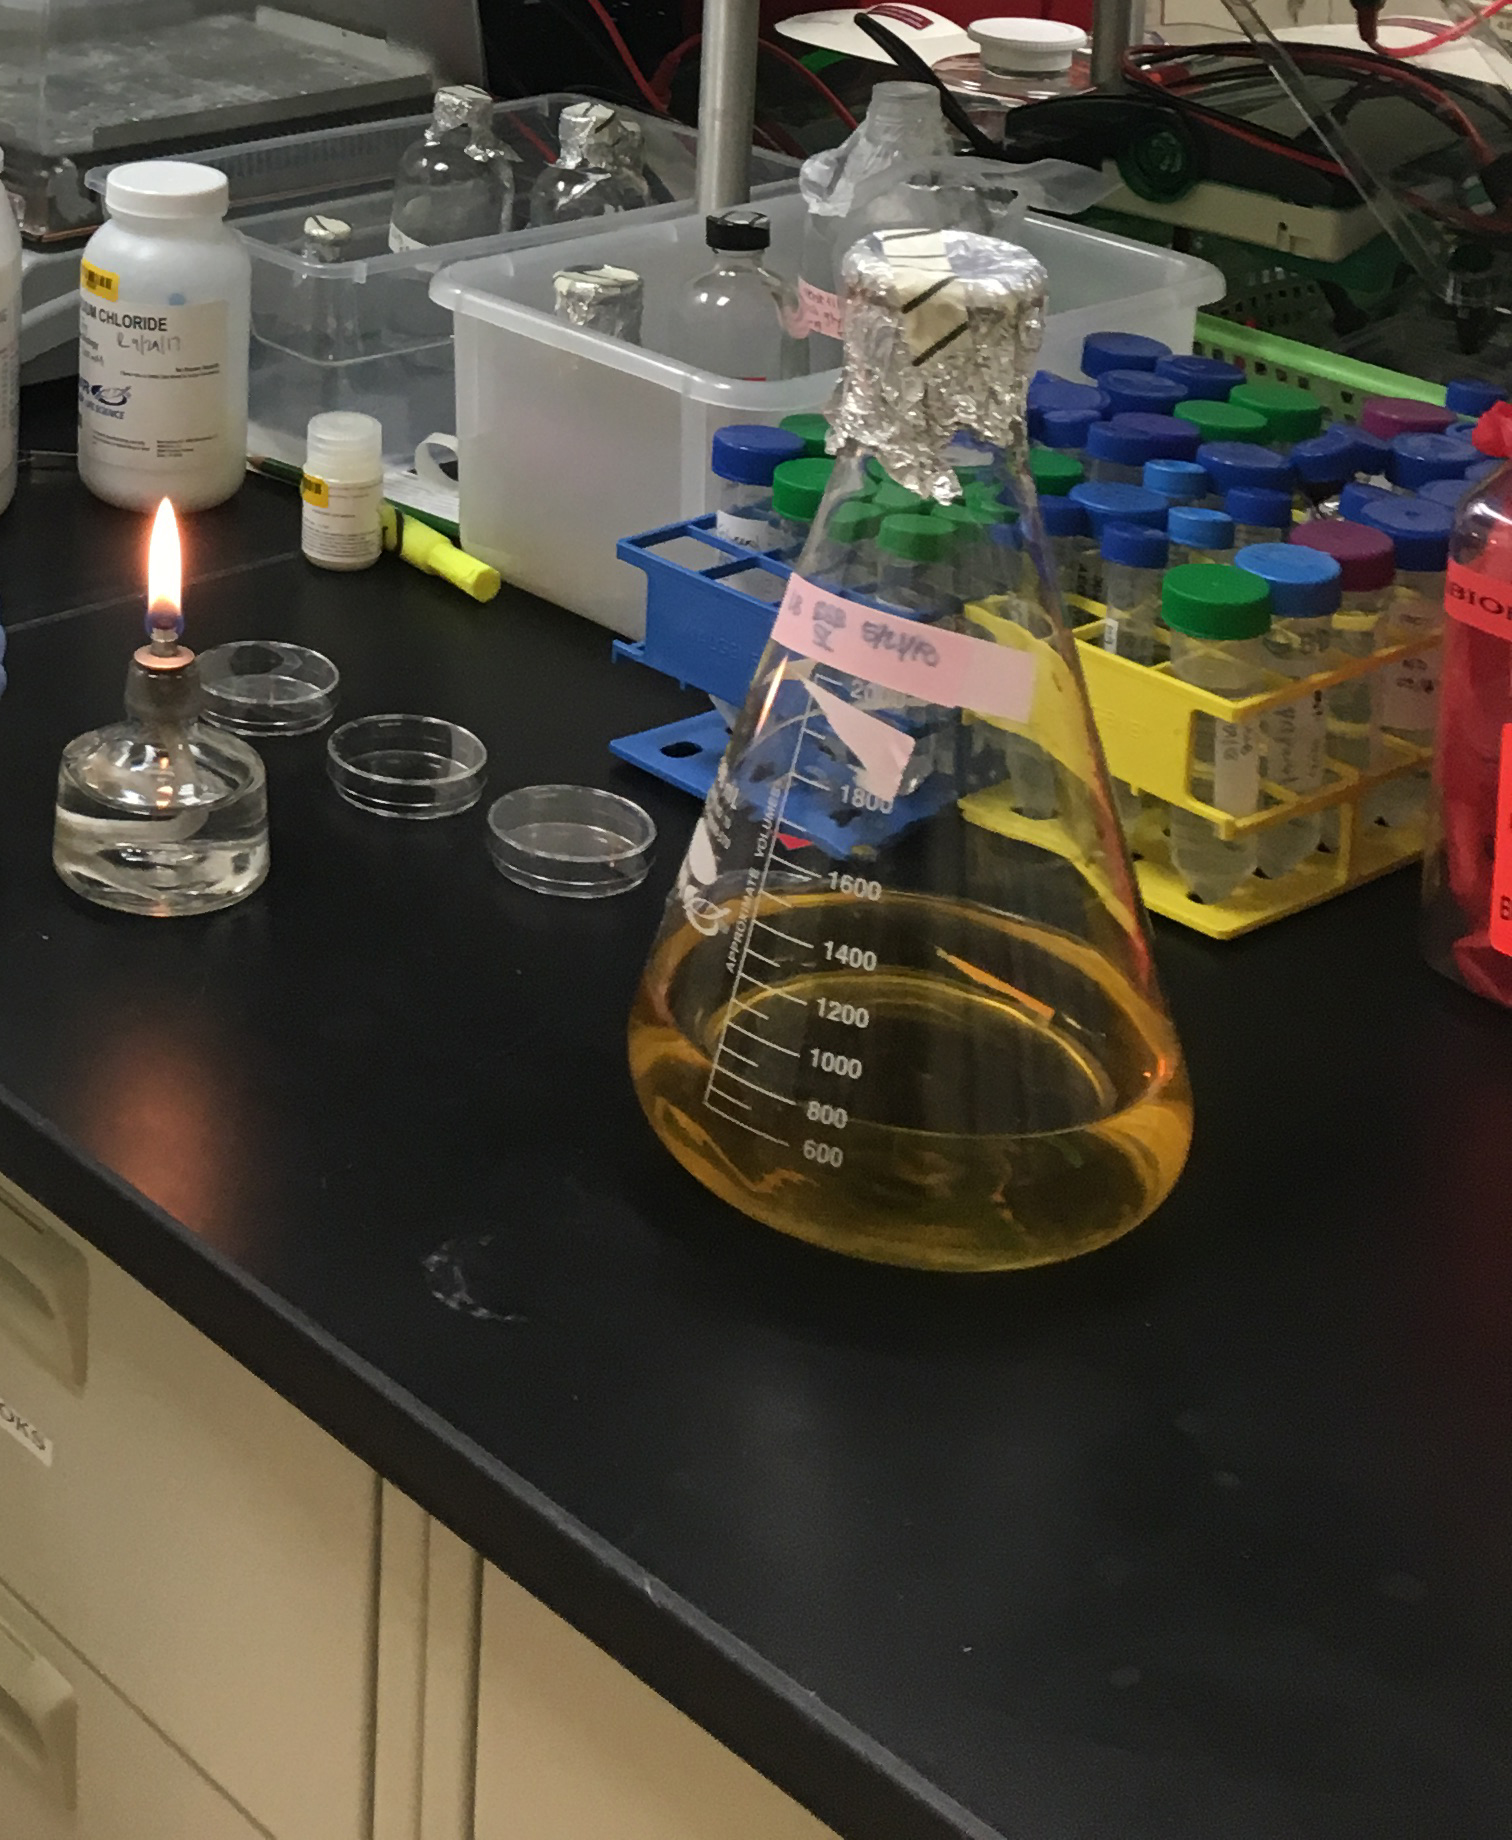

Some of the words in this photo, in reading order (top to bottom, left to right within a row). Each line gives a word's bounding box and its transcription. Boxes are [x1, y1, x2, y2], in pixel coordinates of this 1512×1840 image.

[99, 309, 168, 332] CHLORIDE
[827, 871, 883, 902] 1600
[726, 866, 761, 974] APPROXIMATE
[823, 940, 878, 972] 1400
[816, 997, 870, 1029] 1200
[810, 1048, 863, 1079] 1000
[806, 1101, 849, 1129] 800
[803, 1140, 843, 1168] 600
